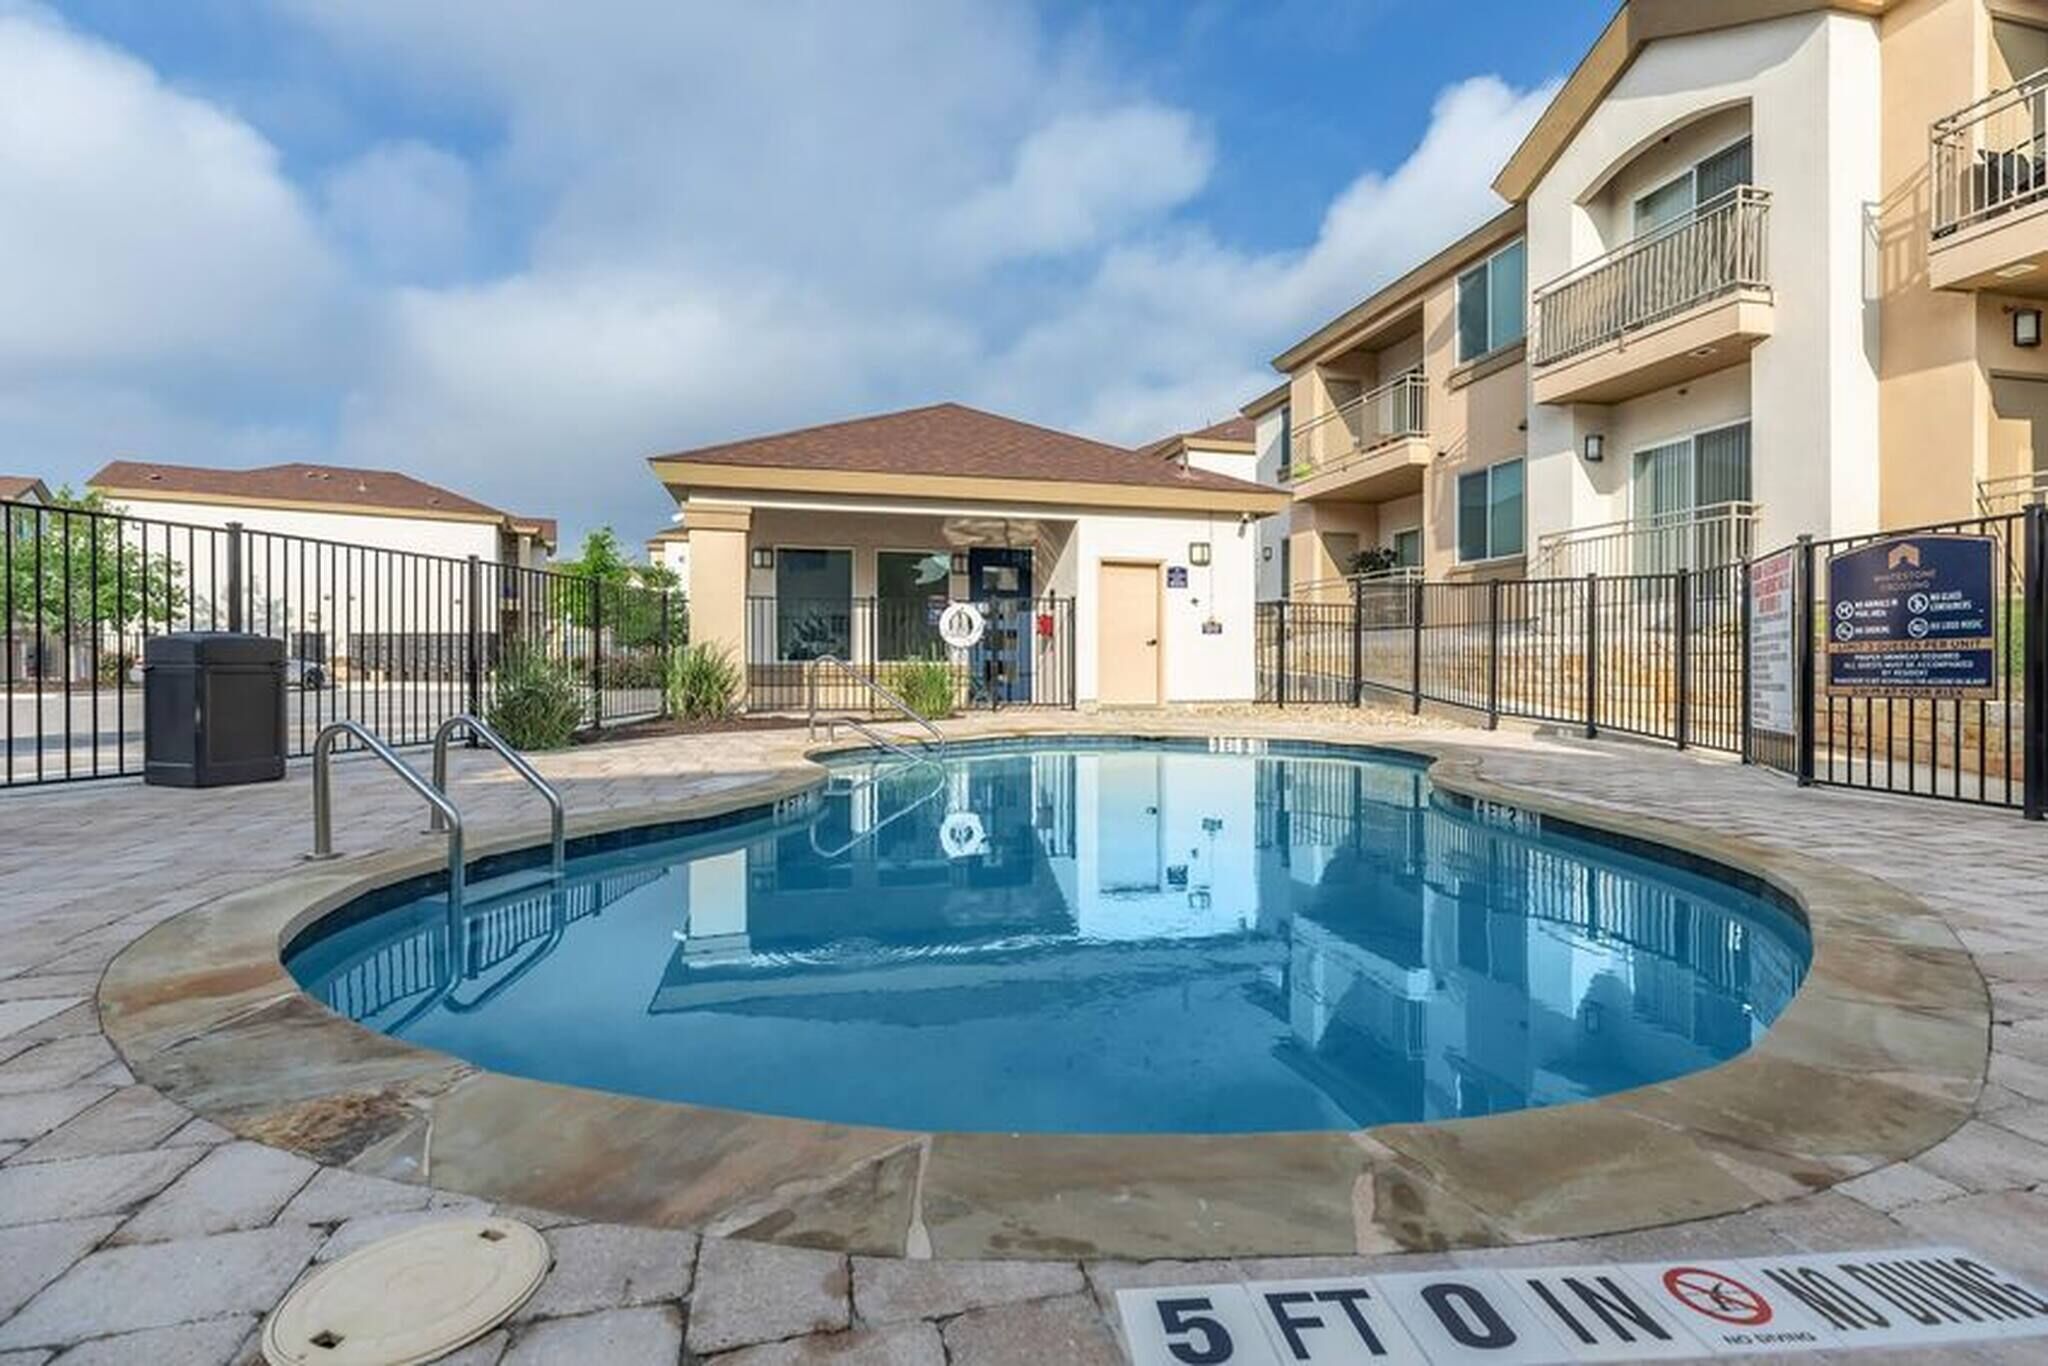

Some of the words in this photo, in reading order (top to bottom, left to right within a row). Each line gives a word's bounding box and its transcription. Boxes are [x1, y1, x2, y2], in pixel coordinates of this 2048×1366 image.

[1930, 592, 1940, 601] NO
[1951, 639, 1981, 649] UNIT
[1762, 1266, 1891, 1332] NO
[1838, 1257, 2048, 1326] DIVING
[1156, 1297, 1235, 1366] 5
[1264, 1288, 1388, 1360] FT
[1526, 1276, 1673, 1345] IN
[1723, 1334, 1753, 1347] NO
[1755, 1330, 1818, 1345] DIVING
